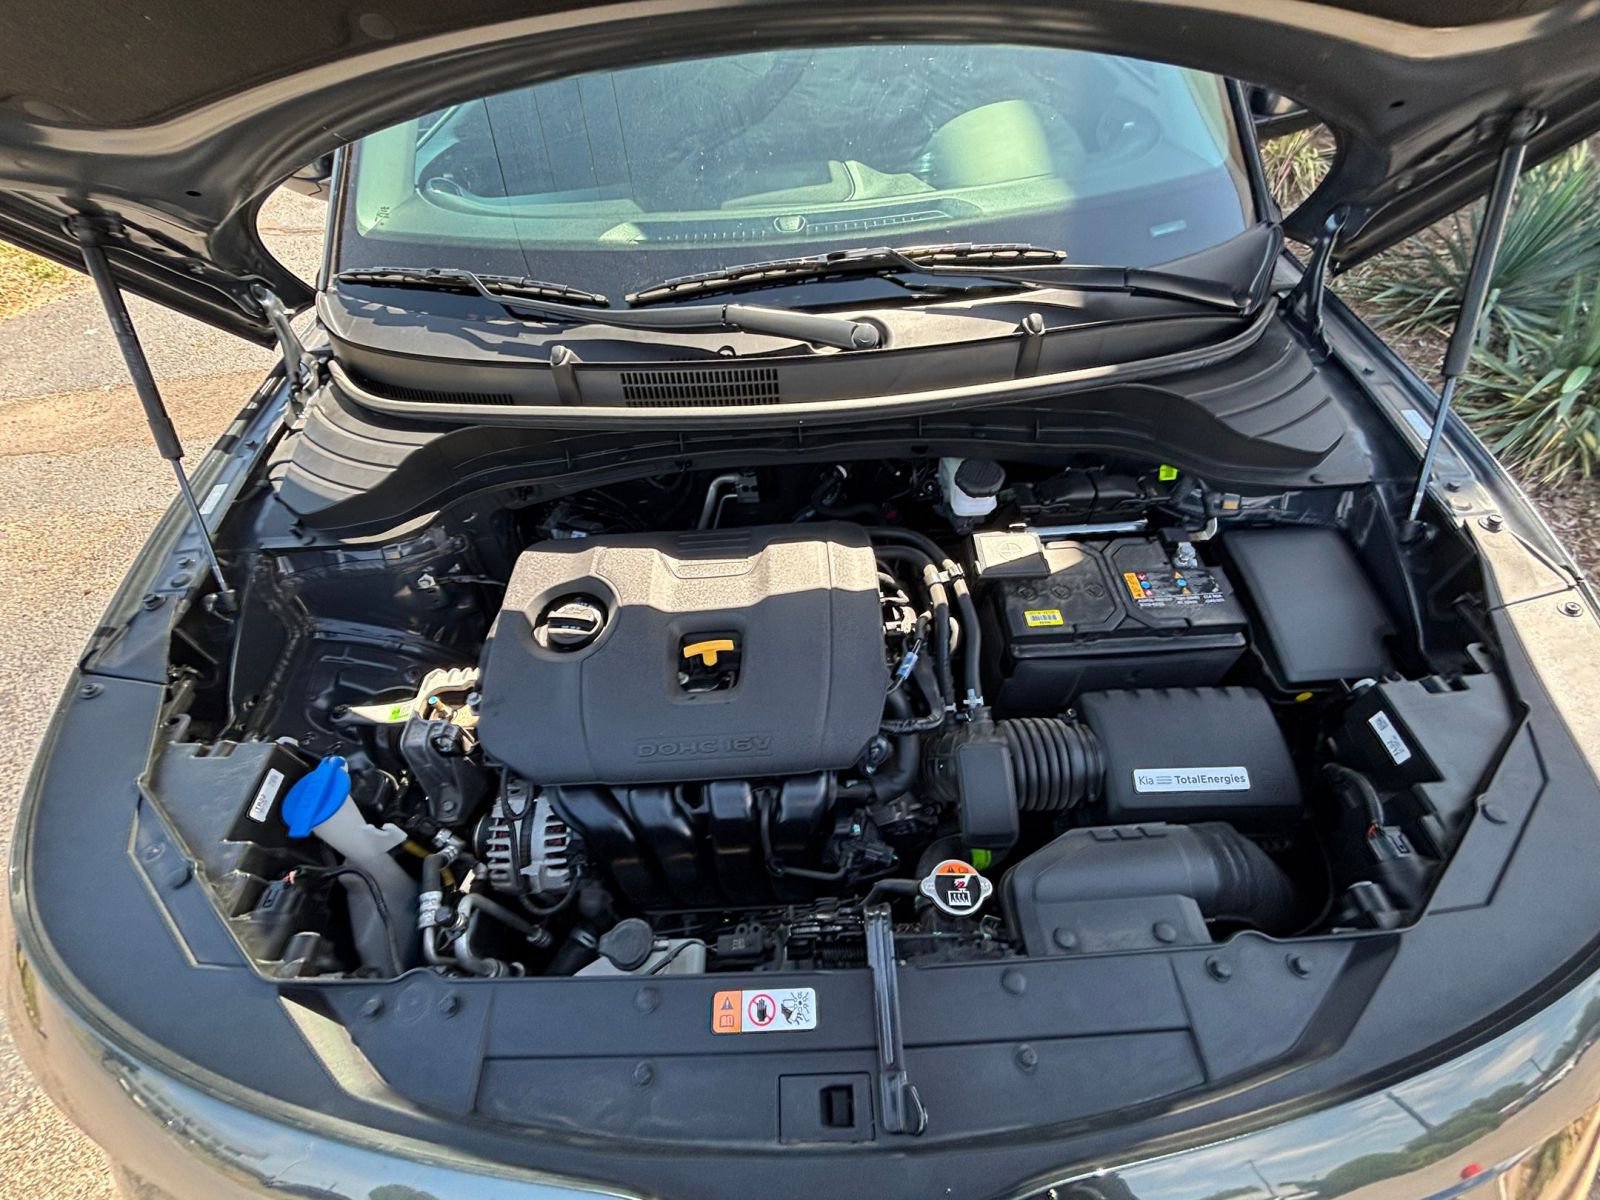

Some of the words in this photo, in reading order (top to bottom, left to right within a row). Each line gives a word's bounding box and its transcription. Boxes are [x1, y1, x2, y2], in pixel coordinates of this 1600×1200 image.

[636, 739, 718, 758] DOHC
[726, 736, 772, 753] 16V
[1138, 775, 1155, 785] Kia
[1174, 774, 1246, 785] TotalEnergies
